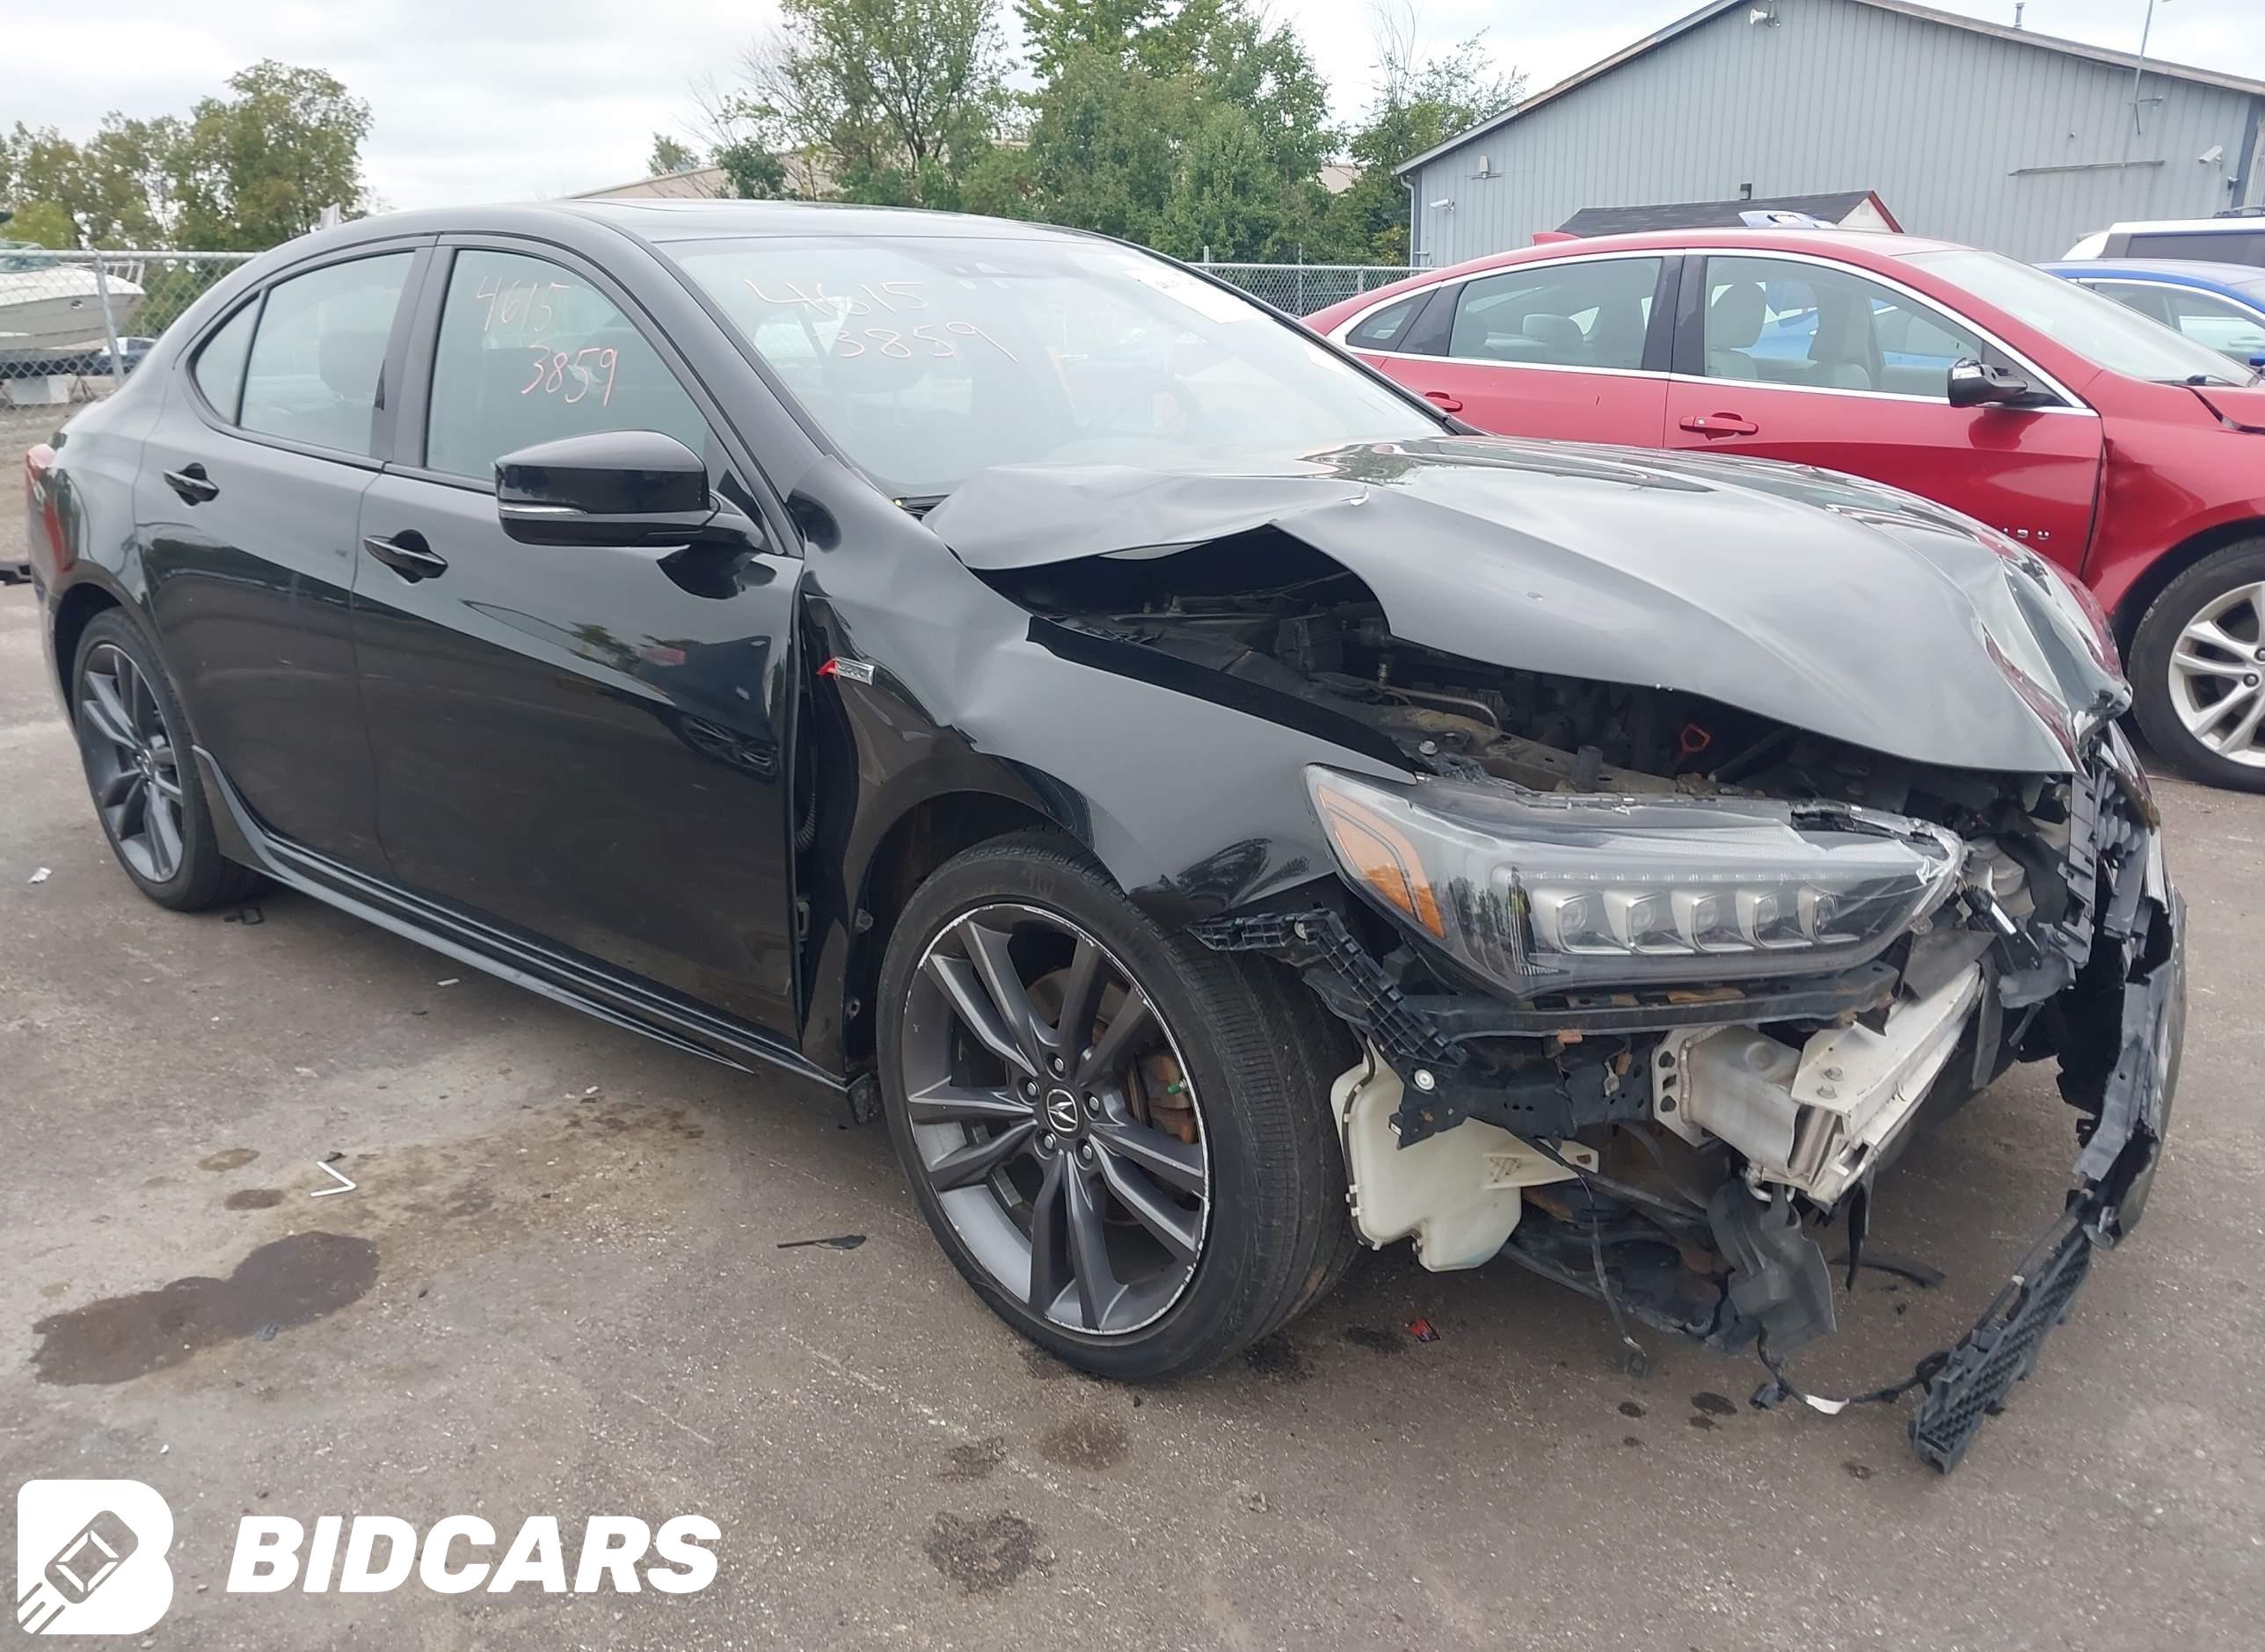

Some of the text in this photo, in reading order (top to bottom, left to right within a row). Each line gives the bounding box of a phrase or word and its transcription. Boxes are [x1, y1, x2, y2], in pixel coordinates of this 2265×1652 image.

[476, 275, 571, 332] 4615
[745, 279, 929, 317] 4615
[814, 322, 1018, 363] 3859
[521, 344, 618, 407] 3859
